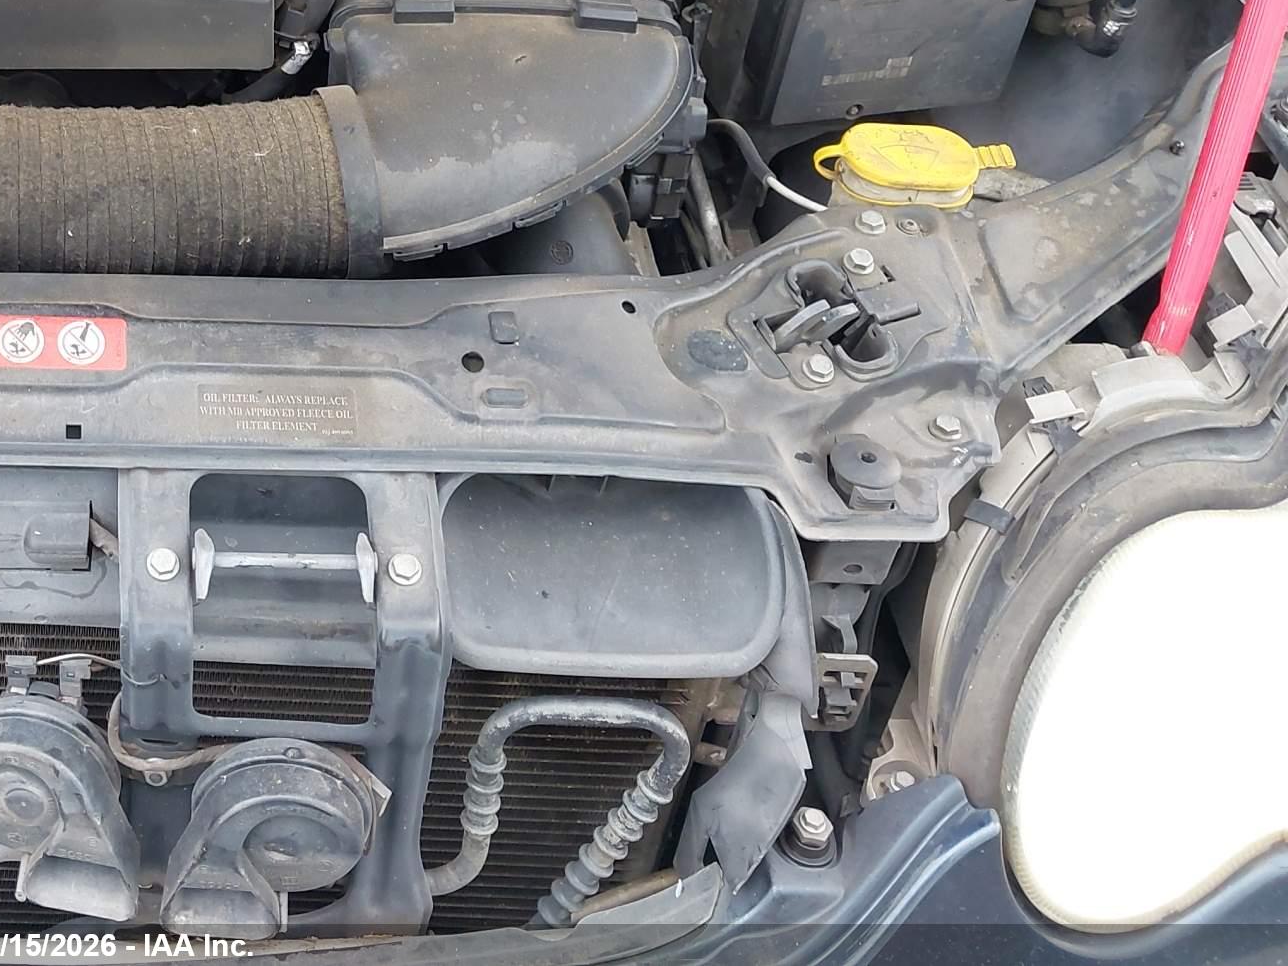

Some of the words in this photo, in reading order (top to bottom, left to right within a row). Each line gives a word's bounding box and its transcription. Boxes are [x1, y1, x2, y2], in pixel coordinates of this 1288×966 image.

[203, 393, 220, 403] OIL
[265, 395, 302, 405] ALWAYS
[304, 395, 348, 406] REPLACE
[200, 406, 226, 416] WITH
[245, 407, 295, 418] APPROVED
[297, 408, 335, 418] FLEECE
[336, 409, 353, 419] OIL
[236, 420, 271, 430] FILTER
[272, 421, 318, 431] ELEMENT
